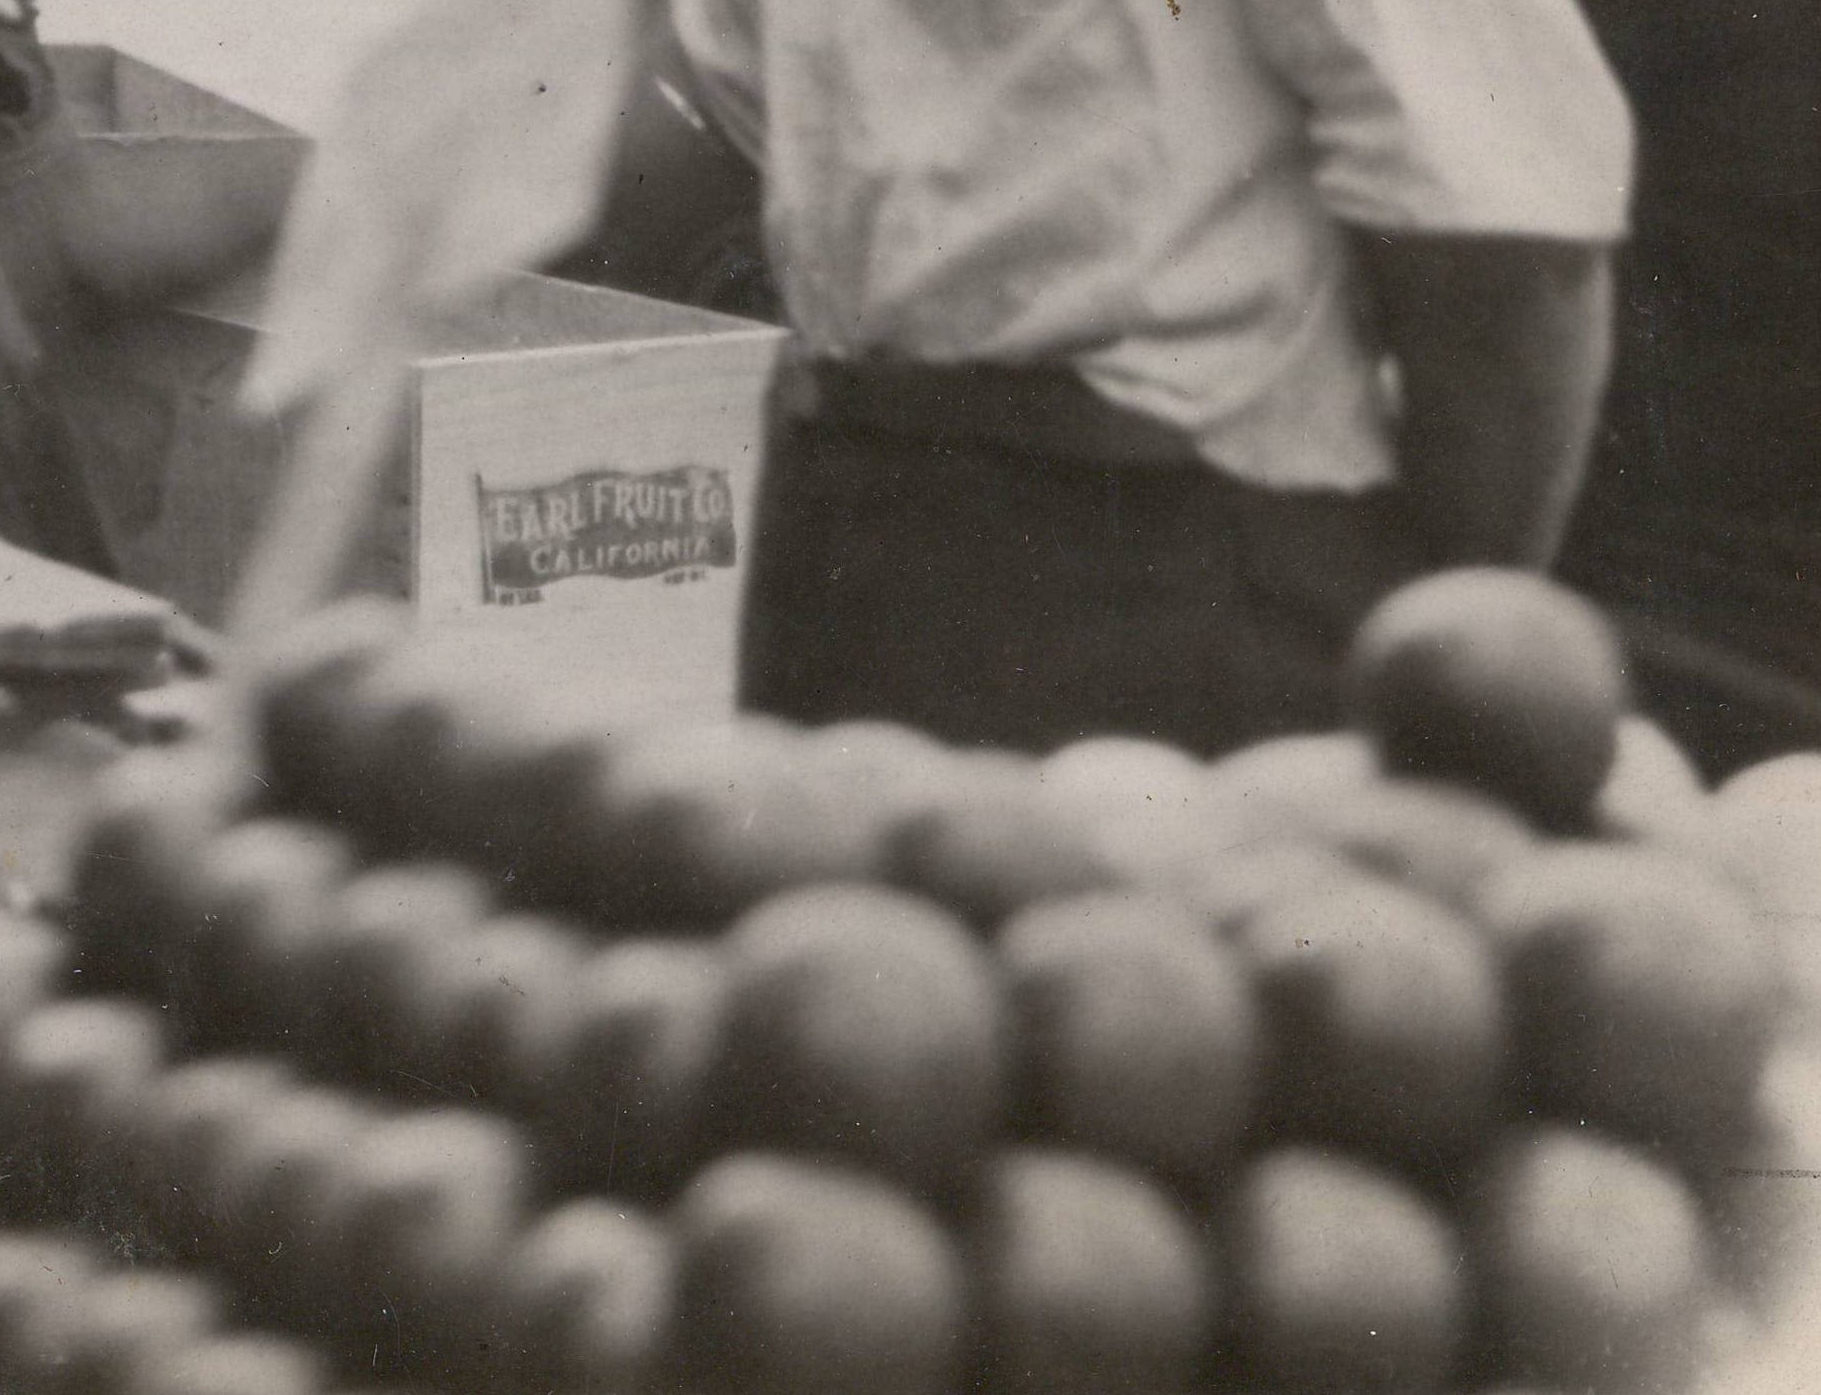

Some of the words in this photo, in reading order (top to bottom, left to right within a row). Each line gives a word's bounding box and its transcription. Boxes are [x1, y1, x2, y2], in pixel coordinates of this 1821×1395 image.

[496, 491, 587, 540] EARL
[593, 479, 690, 529] FRUIT
[531, 538, 709, 573] CALIFORNIA
